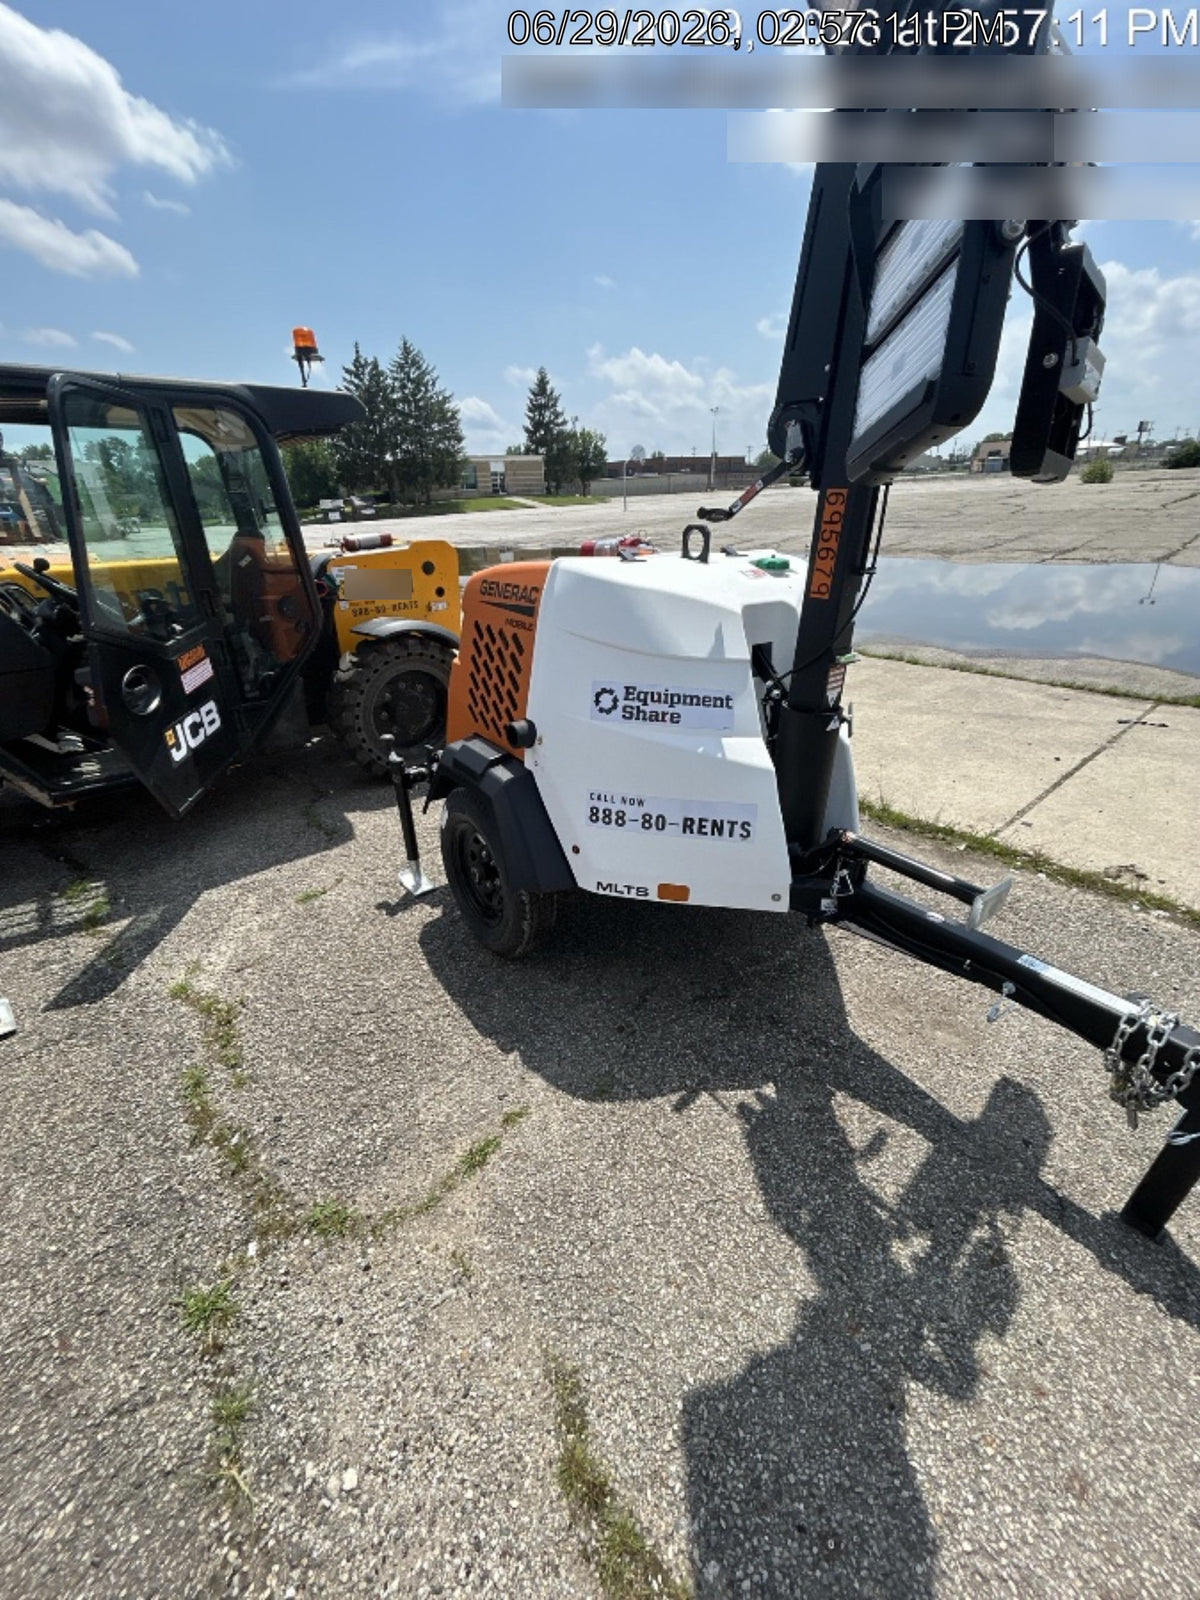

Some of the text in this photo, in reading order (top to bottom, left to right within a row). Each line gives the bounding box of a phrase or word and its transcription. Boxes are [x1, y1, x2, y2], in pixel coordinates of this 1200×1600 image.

[809, 491, 846, 597] 695679
[480, 579, 540, 605] GENERAC
[622, 685, 734, 710] Equipment
[621, 705, 682, 725] Share
[170, 699, 221, 762] JCB
[589, 792, 646, 807] CALL NOW
[588, 806, 752, 841] 888-80-RENTS
